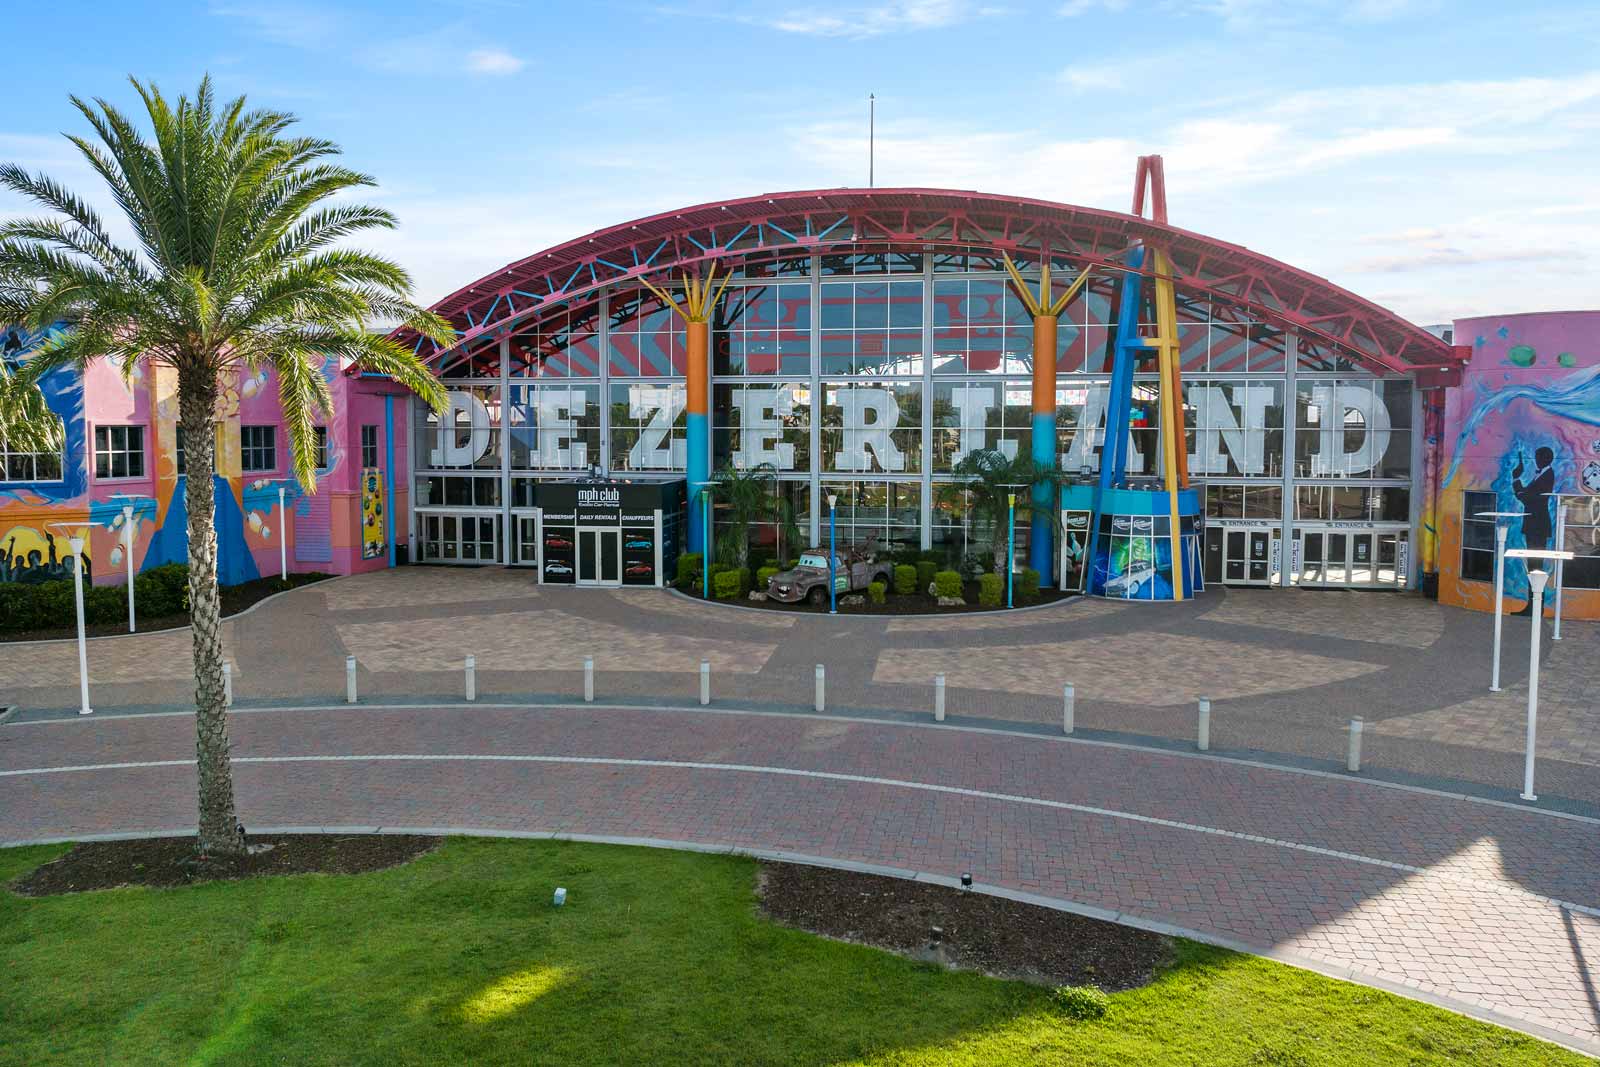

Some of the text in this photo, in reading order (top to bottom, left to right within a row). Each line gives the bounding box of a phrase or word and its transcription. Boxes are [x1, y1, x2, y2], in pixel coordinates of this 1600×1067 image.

[430, 386, 1392, 475] DEZERLAND
[578, 487, 620, 503] mph club
